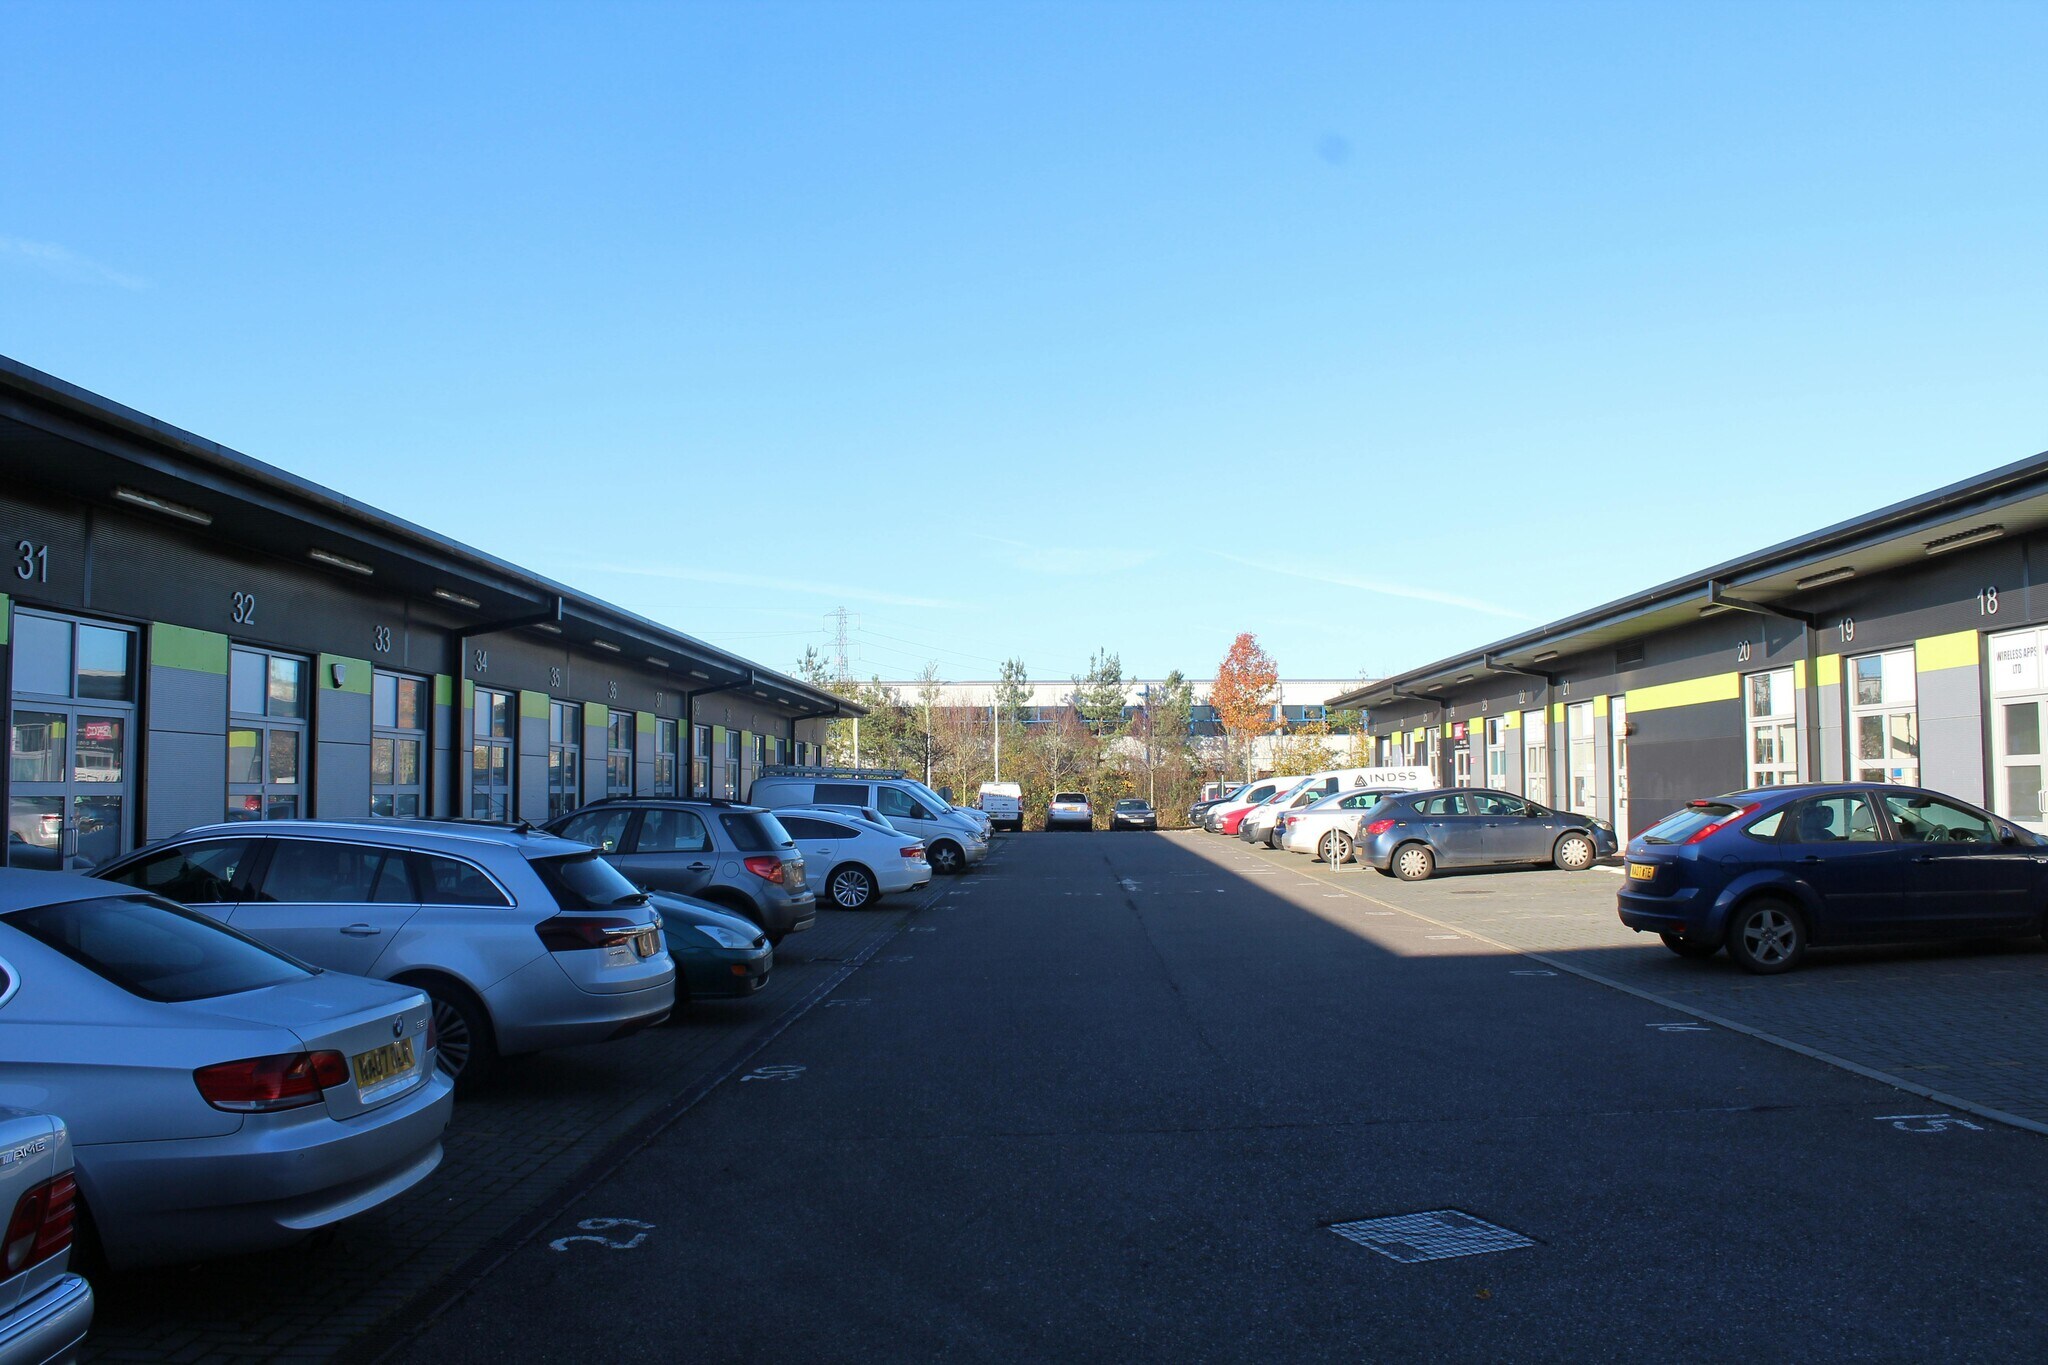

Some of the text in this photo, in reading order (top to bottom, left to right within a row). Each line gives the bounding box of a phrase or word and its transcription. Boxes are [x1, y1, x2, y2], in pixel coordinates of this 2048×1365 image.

[16, 540, 48, 583] 31
[231, 592, 255, 626] 32
[1977, 585, 1999, 616] 18
[373, 625, 391, 653] 33
[1838, 618, 1855, 643] 19
[475, 649, 488, 673] 34
[1737, 640, 1750, 662] 20
[1997, 648, 2022, 661] WIRELESS
[2023, 646, 2037, 659] APPS
[550, 667, 561, 688] 35
[2012, 663, 2022, 674] LTD
[609, 681, 617, 700] 36
[1519, 689, 1527, 704] 22
[1562, 680, 1571, 696] 21
[656, 691, 663, 708] 37
[1481, 698, 1488, 712] 23
[1369, 772, 1417, 783] INDSS
[738, 1064, 807, 1082] 30
[1873, 1112, 1984, 1134] 15
[549, 1217, 656, 1252] 29
